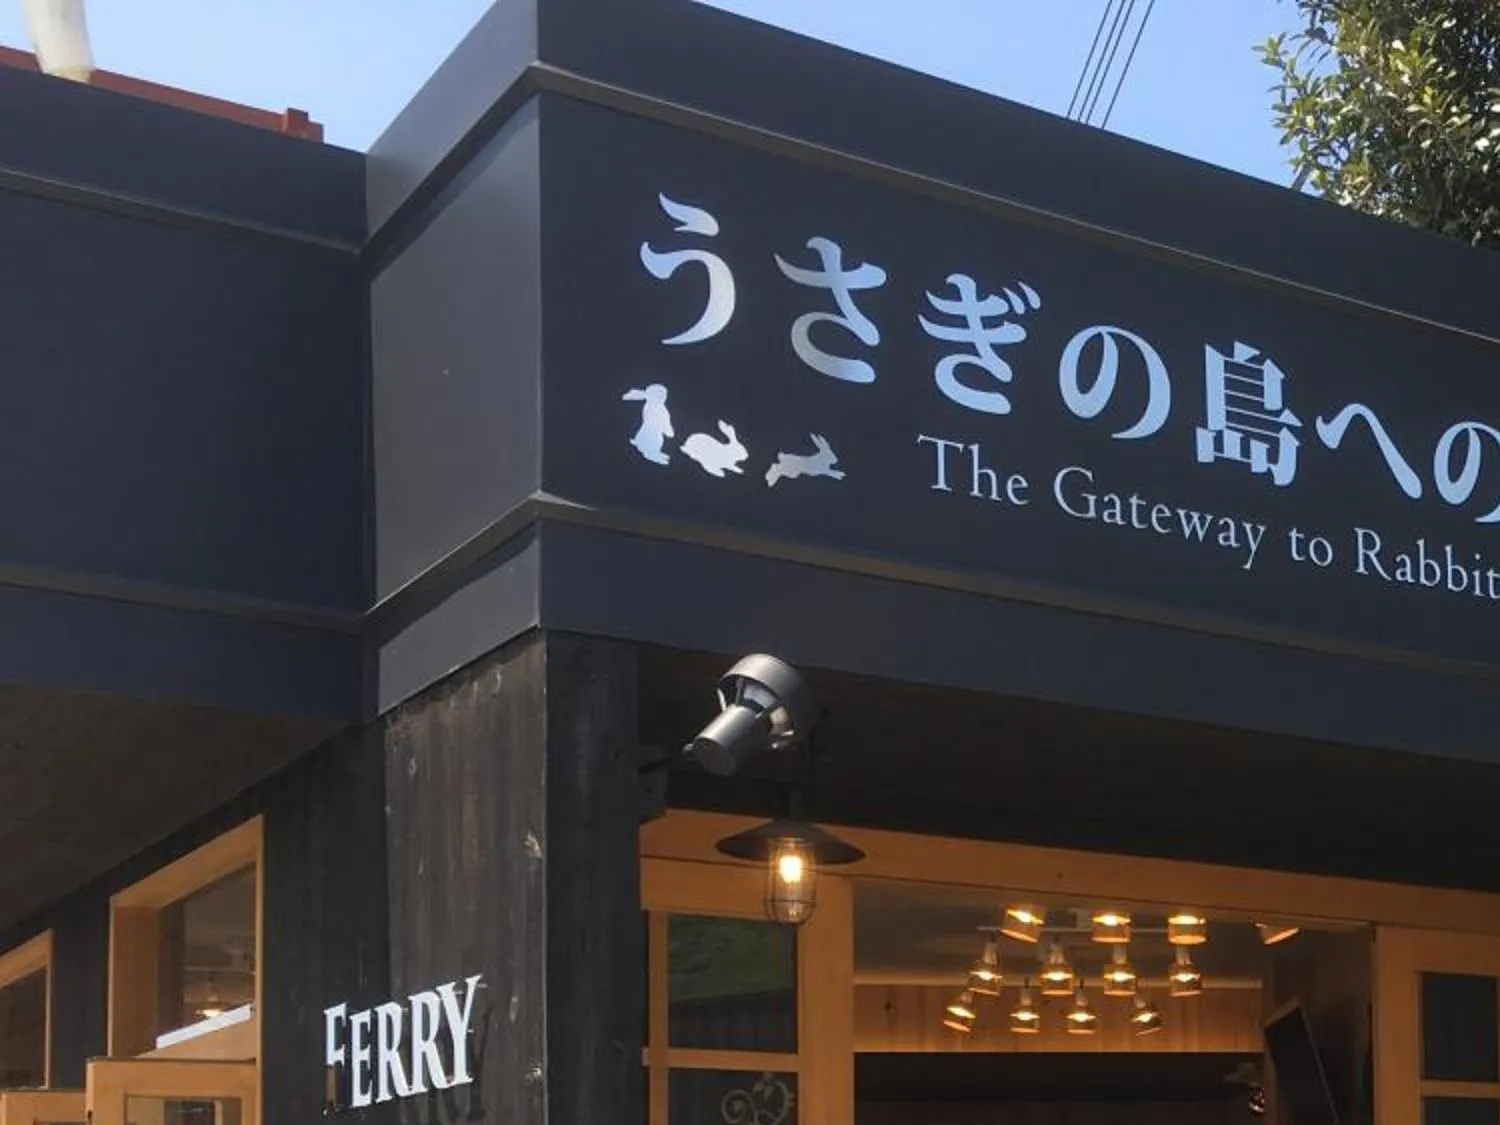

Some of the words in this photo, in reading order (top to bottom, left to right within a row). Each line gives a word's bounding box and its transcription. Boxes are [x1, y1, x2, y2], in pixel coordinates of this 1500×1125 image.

[916, 432, 1030, 506] The
[1053, 465, 1266, 571] Gateway
[1288, 526, 1334, 568] to
[323, 974, 483, 1116] FERRY
